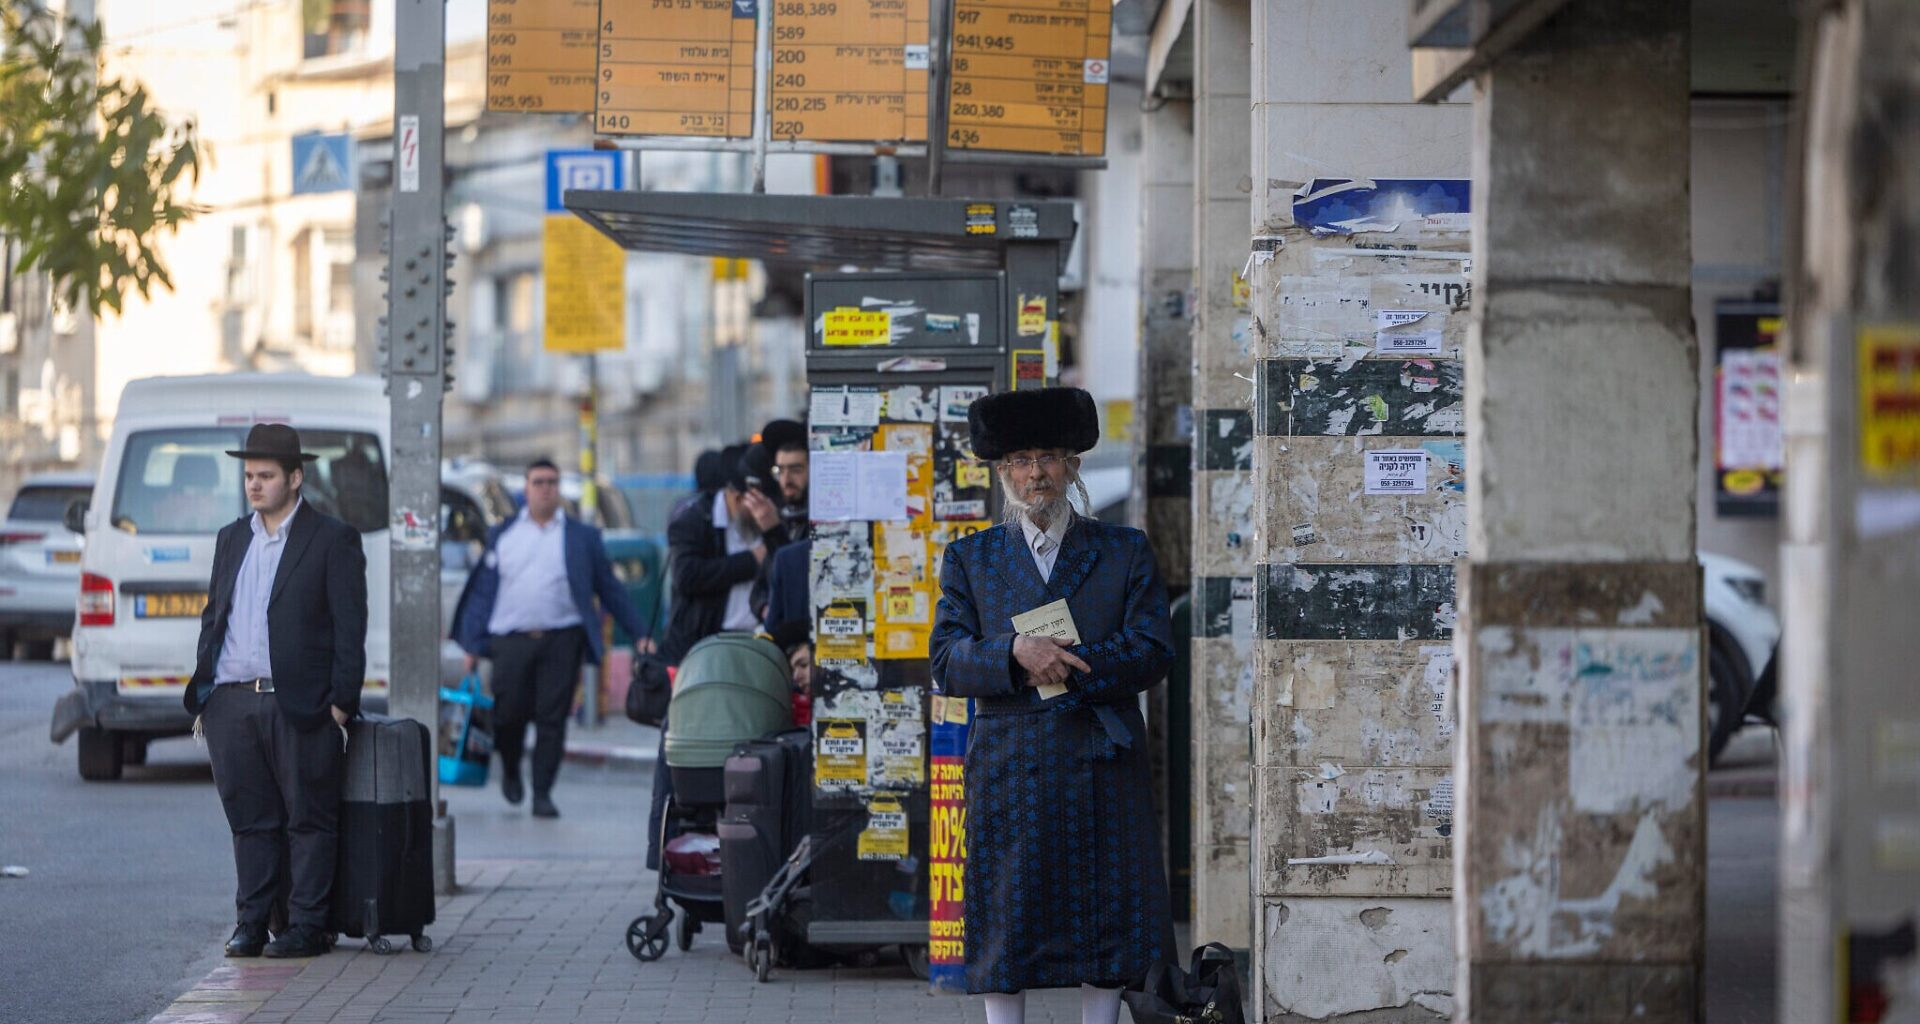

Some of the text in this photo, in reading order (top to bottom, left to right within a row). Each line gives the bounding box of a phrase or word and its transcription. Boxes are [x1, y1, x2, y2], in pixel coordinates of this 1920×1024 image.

[777, 3, 837, 17] 388,389
[957, 11, 980, 24] 917
[603, 20, 613, 33] 4
[776, 26, 805, 40] 589
[491, 33, 516, 45] 690
[956, 35, 1014, 50] 941,945
[603, 44, 612, 57] 5
[712, 48, 729, 57] בית
[776, 50, 805, 63] 200
[491, 54, 512, 65] 691
[955, 59, 968, 71] 18
[490, 75, 510, 86] 917
[603, 69, 612, 81] 9
[776, 74, 805, 87] 240
[953, 82, 972, 95] 28
[601, 92, 610, 104] 9
[776, 97, 826, 111] 210,215
[953, 103, 1004, 118] 280,380
[601, 115, 630, 129] 140
[680, 114, 724, 126] בני ברק
[775, 121, 804, 134] 220
[951, 130, 980, 143] 436
[1379, 462, 1398, 471] לקניה
[930, 863, 964, 911] צדק
